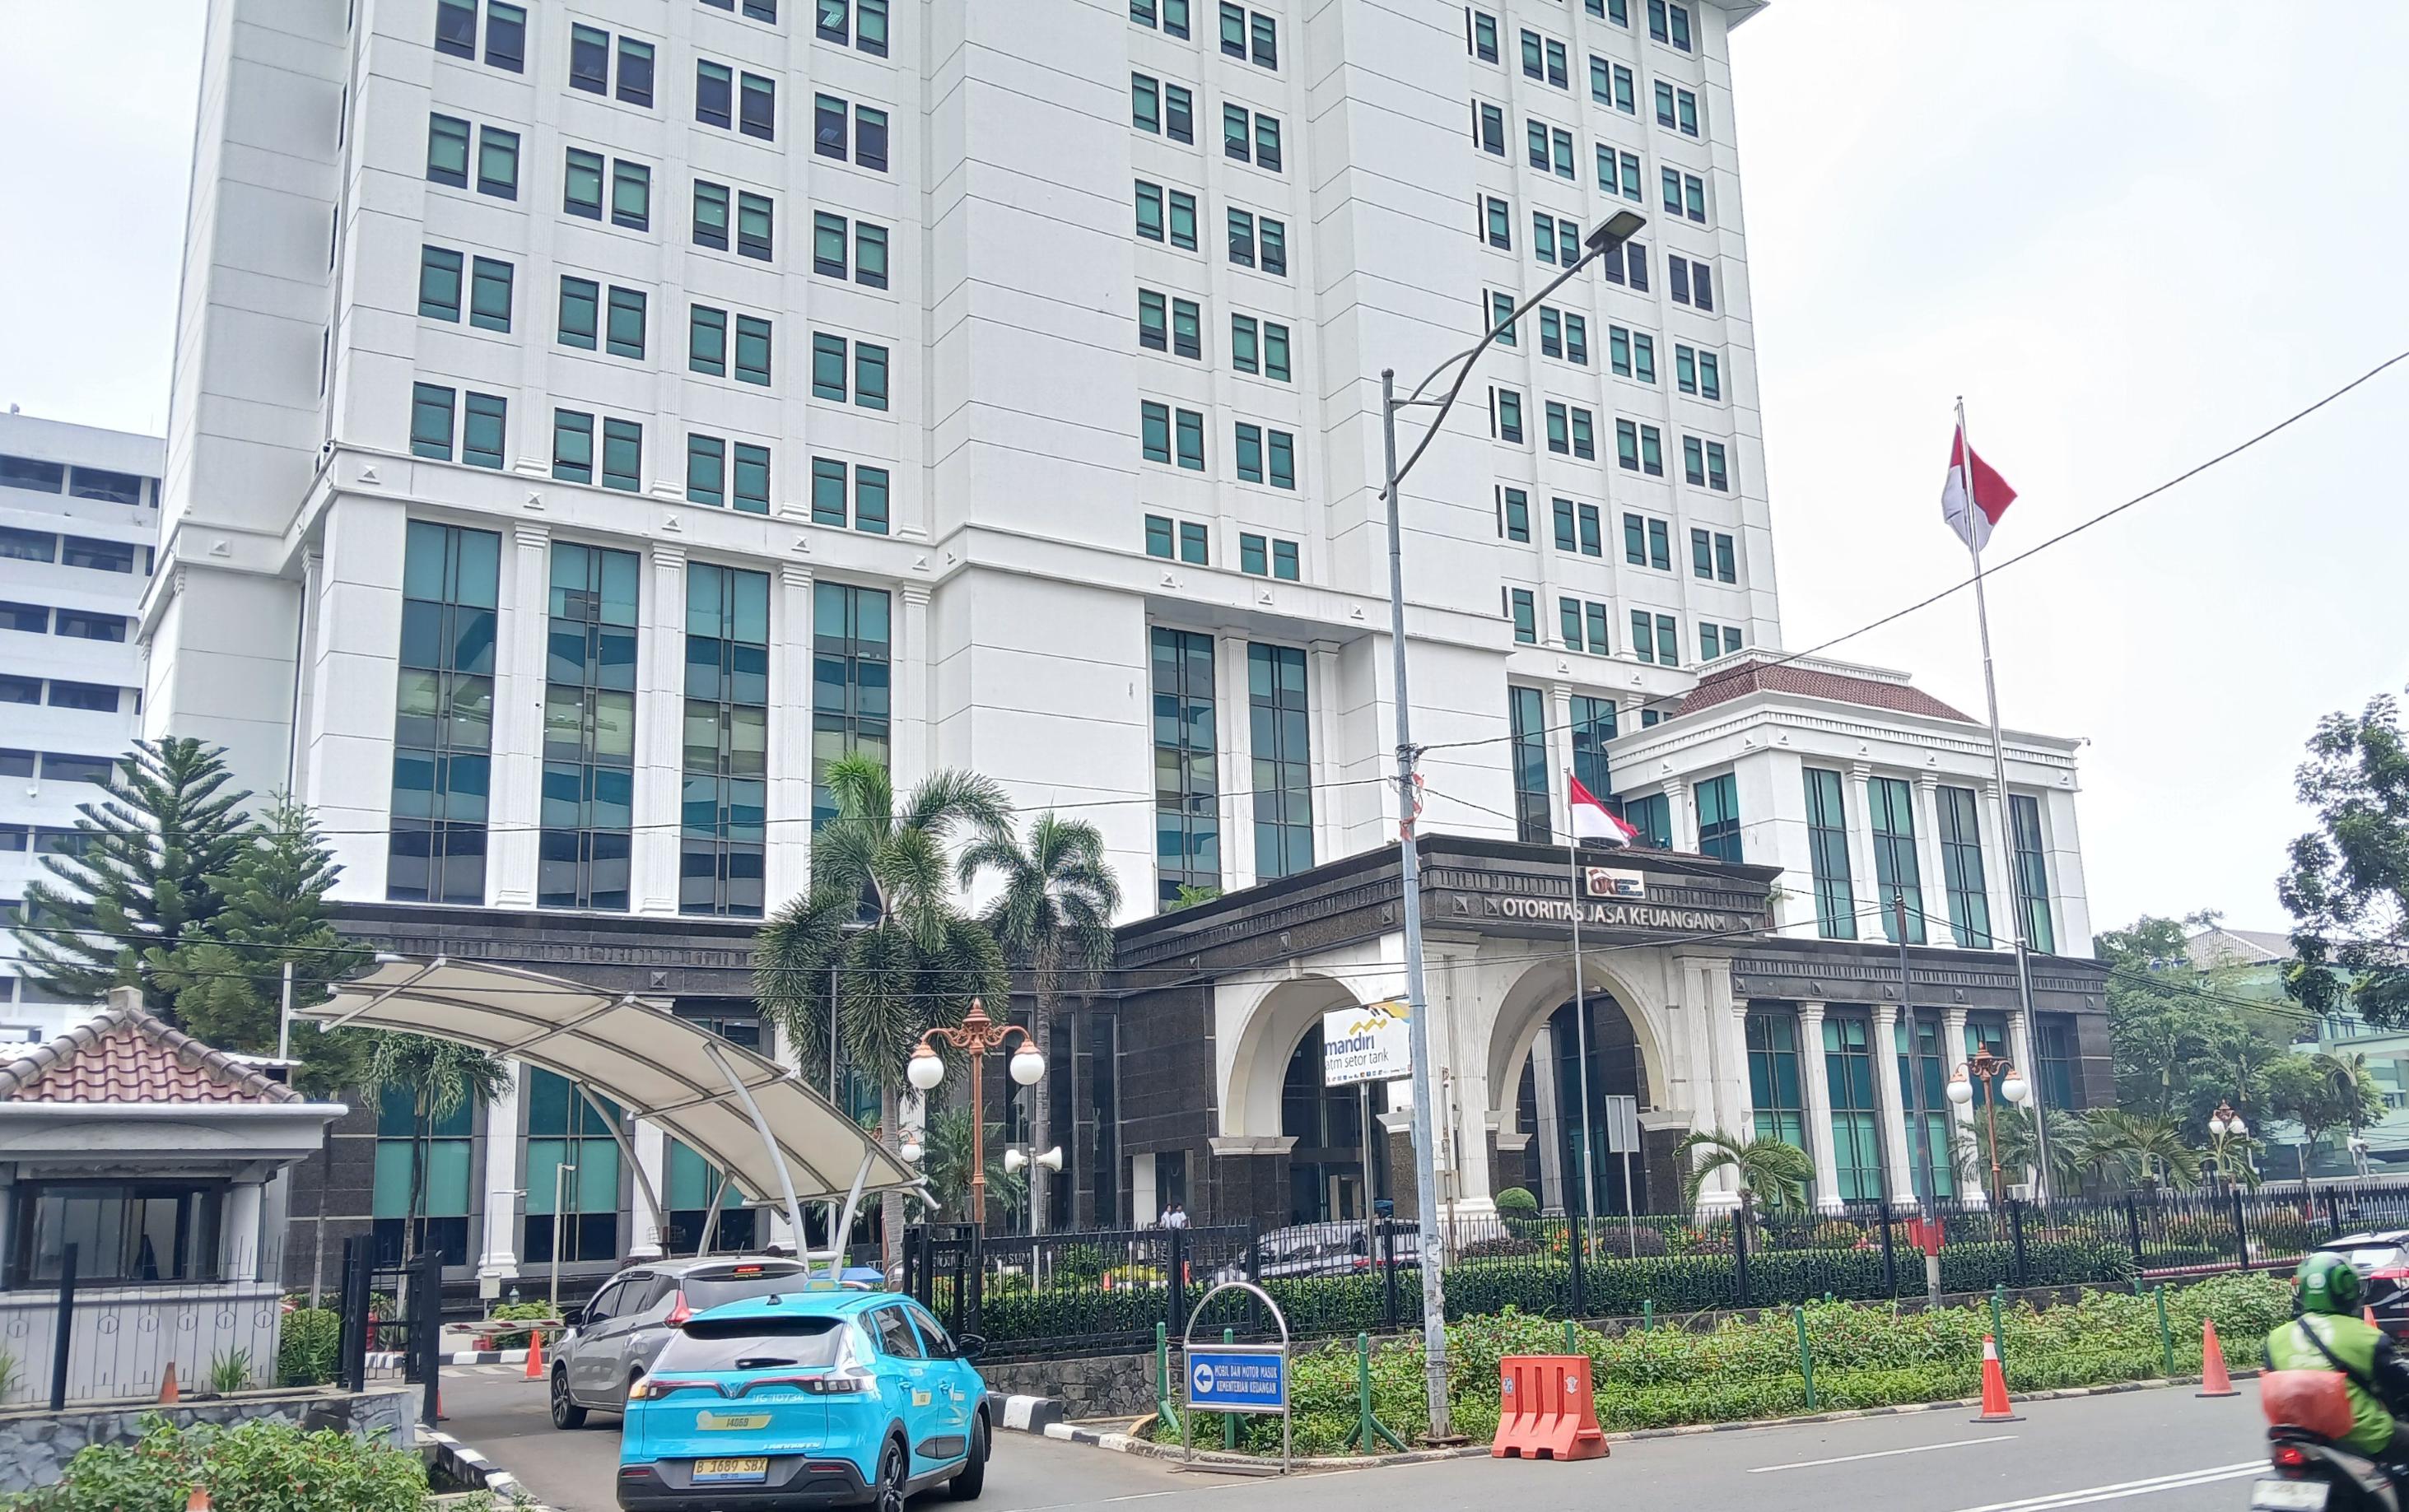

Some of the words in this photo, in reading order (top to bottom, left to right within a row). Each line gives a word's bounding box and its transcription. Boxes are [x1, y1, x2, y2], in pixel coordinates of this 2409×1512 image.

[1503, 897, 1584, 922] OTORITAS
[1587, 905, 1627, 925] JASA
[1629, 907, 1715, 931] KEUANGAN
[1324, 1031, 1374, 1056] mandiri
[1325, 1058, 1343, 1071] atm
[1344, 1054, 1367, 1068] setor
[1230, 1365, 1241, 1377] DAN
[1242, 1365, 1259, 1378] MOTOR
[1260, 1365, 1278, 1379] MASUK
[1216, 1380, 1248, 1393] KEMENTERIAN
[697, 1461, 704, 1473] B
[710, 1459, 739, 1472] 1689
[743, 1458, 766, 1472] SBX
